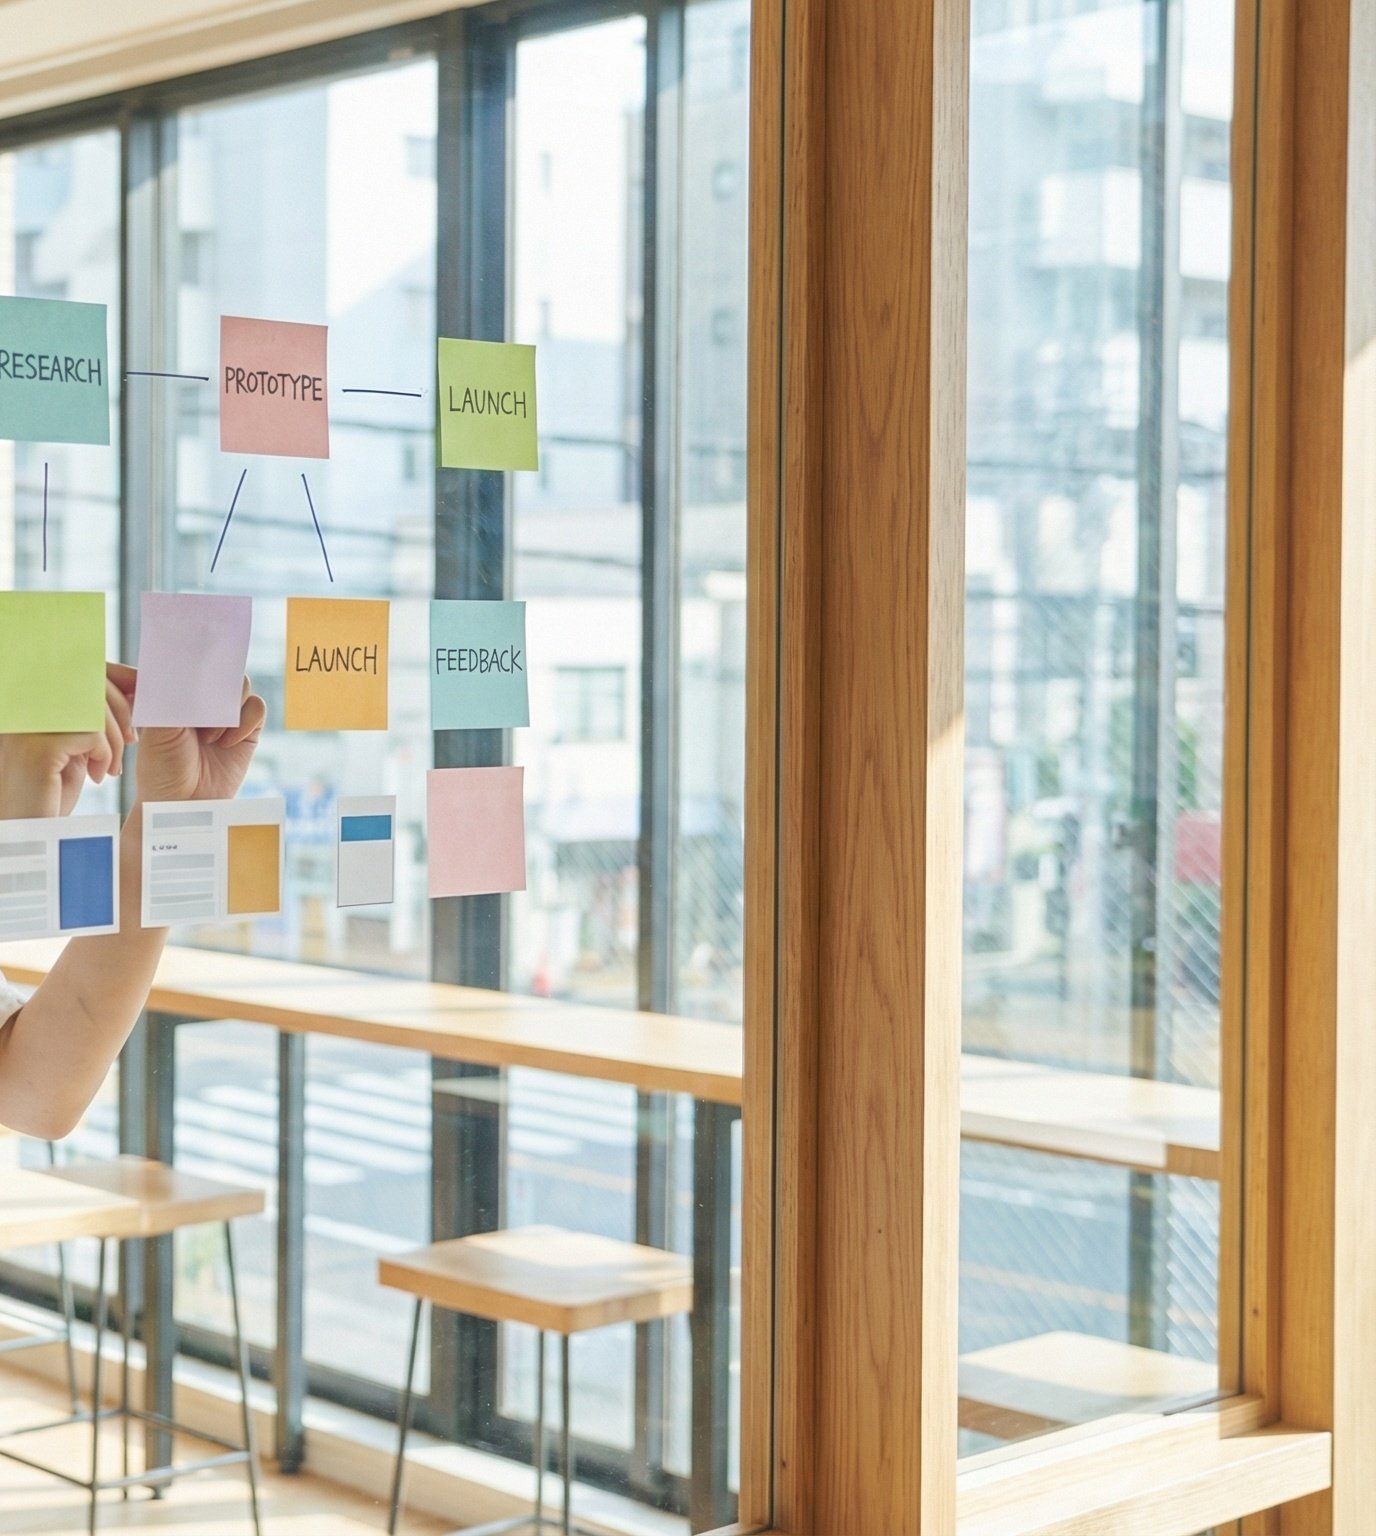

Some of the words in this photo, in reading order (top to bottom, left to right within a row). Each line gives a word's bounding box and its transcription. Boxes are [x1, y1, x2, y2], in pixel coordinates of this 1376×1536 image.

[225, 366, 323, 401] PROTOTYPE
[449, 386, 527, 418] LAUNCH
[296, 644, 378, 675] LAUNCH
[435, 644, 523, 675] FEEDBACK
